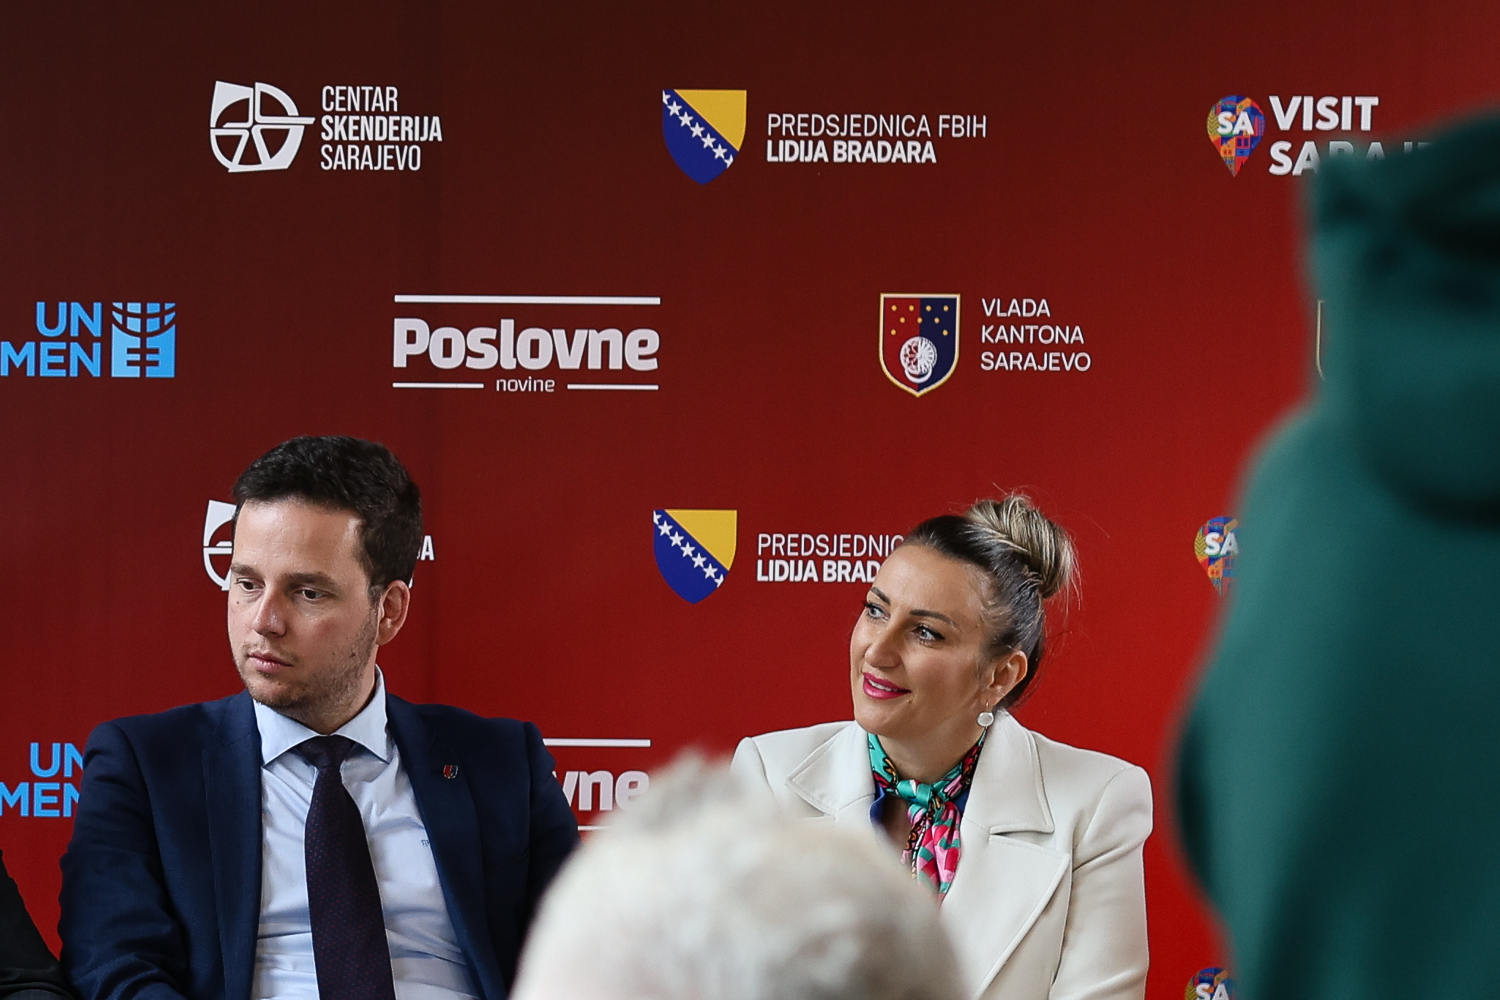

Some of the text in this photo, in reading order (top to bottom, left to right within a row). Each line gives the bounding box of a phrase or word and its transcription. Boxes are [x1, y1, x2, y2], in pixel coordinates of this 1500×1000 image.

[322, 85, 398, 112] CENTAR
[767, 113, 987, 138] PREDSJEDNICA FBIH
[1217, 112, 1254, 135] SA
[1268, 95, 1379, 131] VISIT
[320, 114, 443, 142] SKENDERIJA
[320, 143, 421, 171] SARAJEVO
[766, 139, 937, 164] LIDIJA BRADARA
[36, 301, 103, 338] UN
[981, 298, 1051, 317] VLADA
[393, 317, 660, 371] Poslovne
[981, 324, 1085, 345] KANTONA
[980, 351, 1091, 372] SARAJEVO
[496, 375, 555, 393] novine
[758, 533, 904, 557] PREDSJEDNI
[1204, 531, 1240, 556] SA
[757, 559, 881, 583] LIDIJA BRAD
[30, 742, 84, 778] UN
